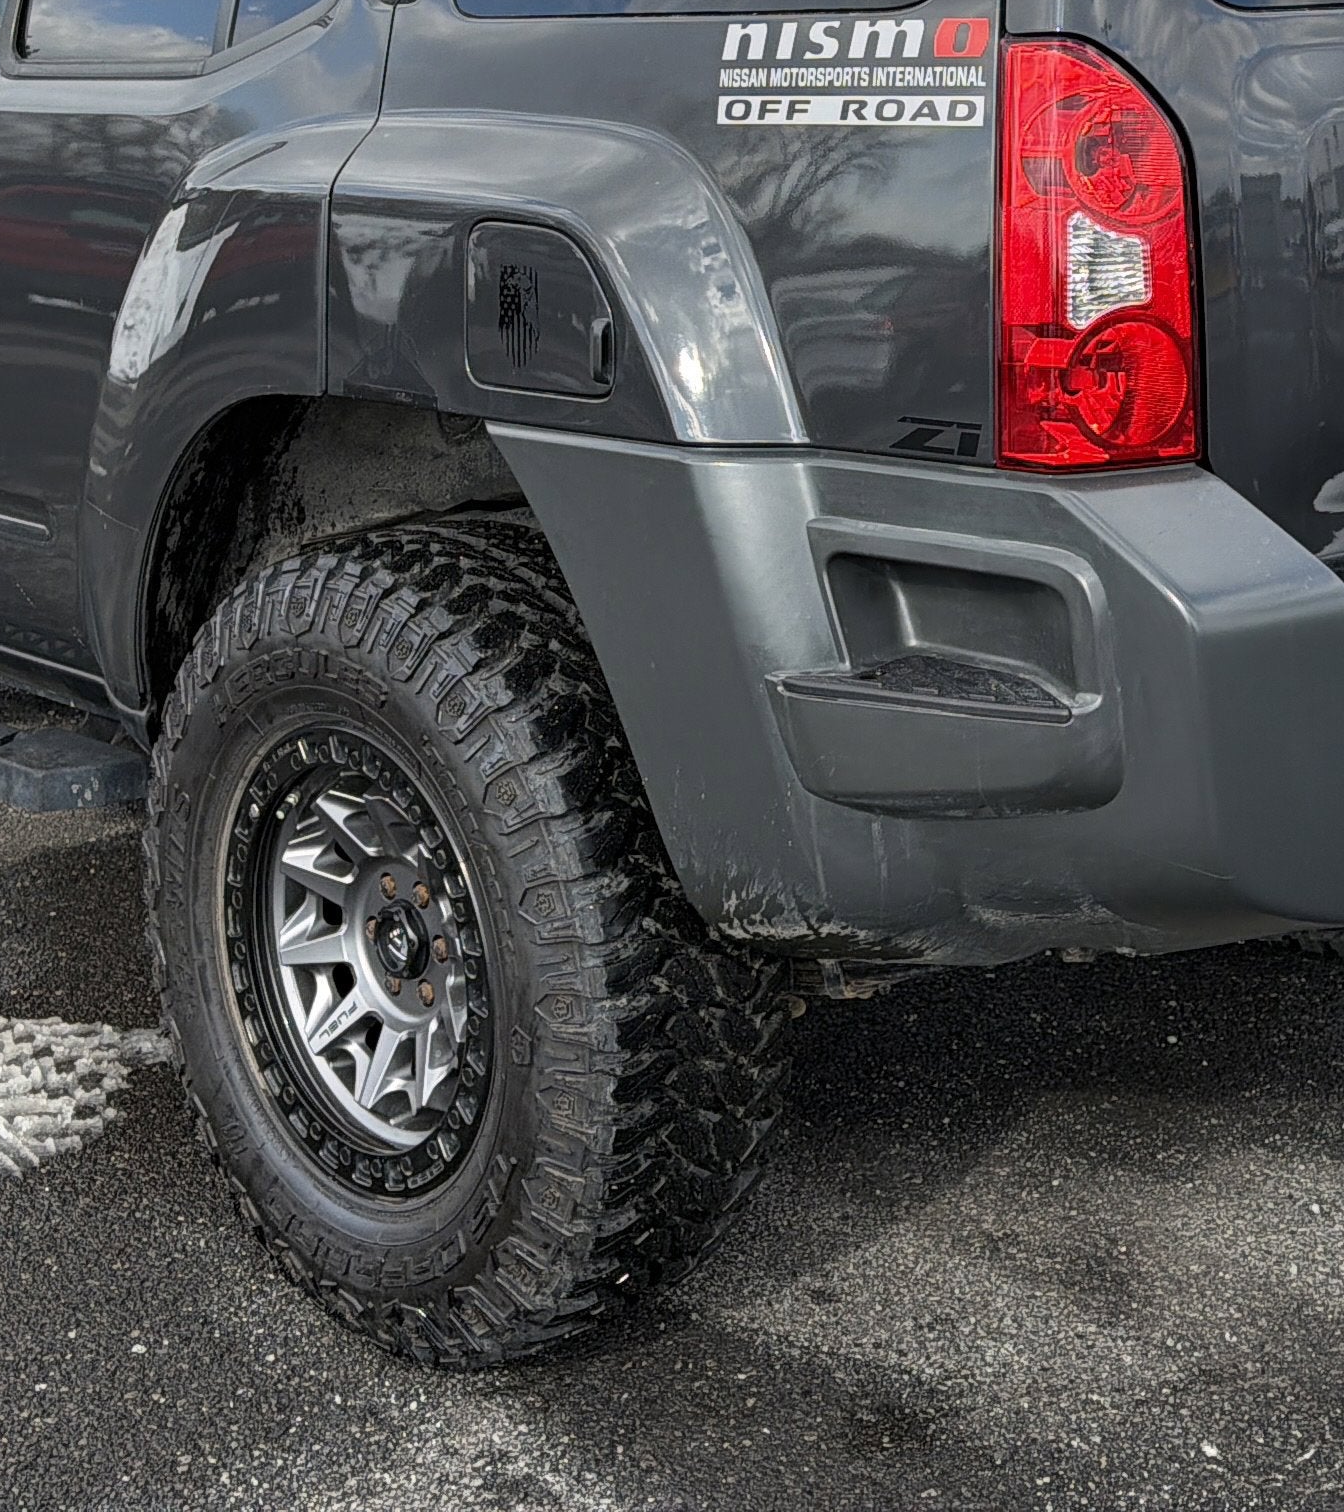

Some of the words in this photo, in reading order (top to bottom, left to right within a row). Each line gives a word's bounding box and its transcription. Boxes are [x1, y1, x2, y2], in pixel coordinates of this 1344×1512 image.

[719, 67, 767, 88] NISSAN
[769, 66, 870, 88] MOTORSPORTS
[872, 65, 987, 88] INTERNATIONAL
[724, 99, 812, 121] OFF
[839, 99, 978, 122] ROAD
[318, 1000, 359, 1040] FUEL
